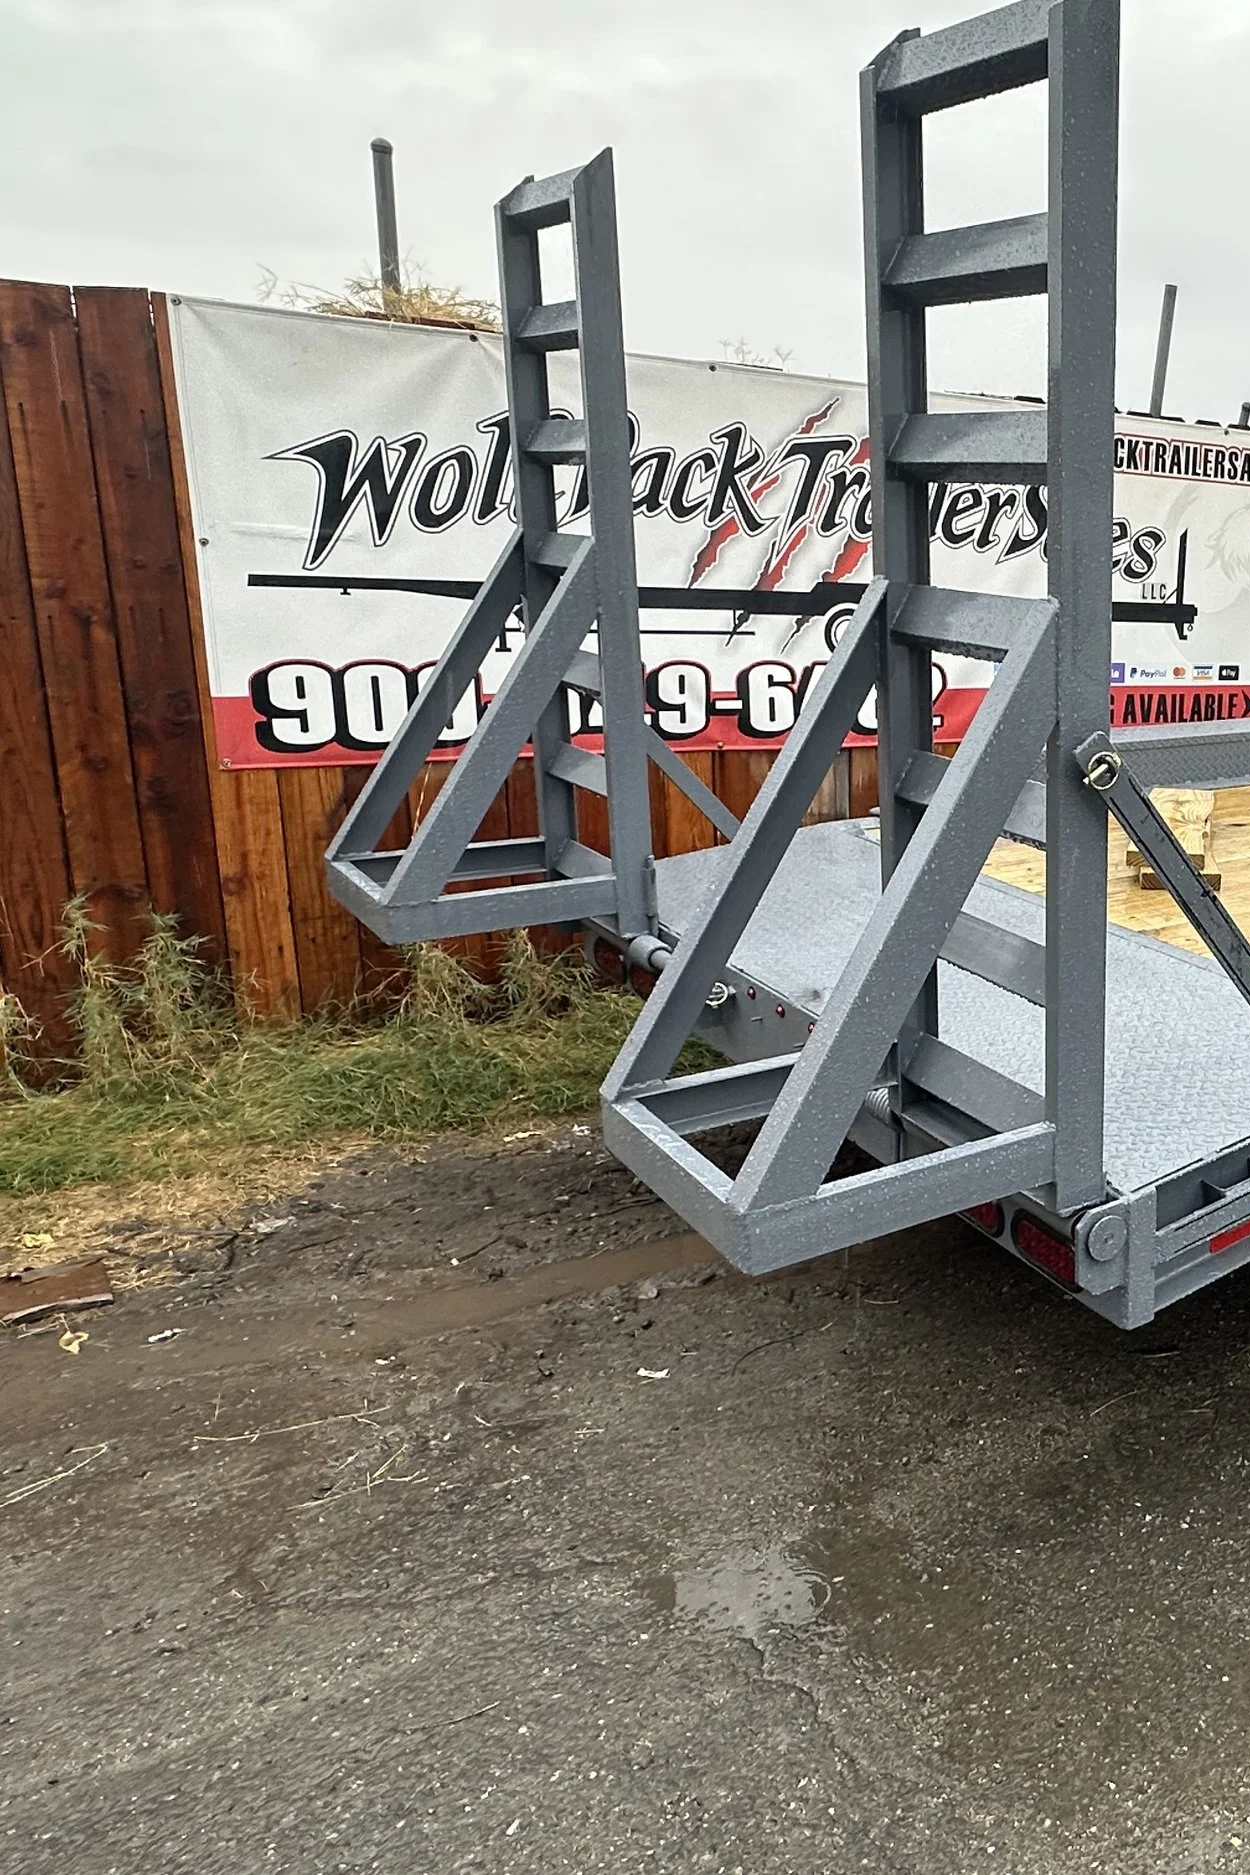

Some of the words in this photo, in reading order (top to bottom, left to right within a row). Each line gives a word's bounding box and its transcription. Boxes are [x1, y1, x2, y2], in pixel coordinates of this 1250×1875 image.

[1141, 583, 1167, 600] LLC
[1139, 668, 1167, 679] PayPal
[1123, 693, 1238, 724] AVAILABLE
